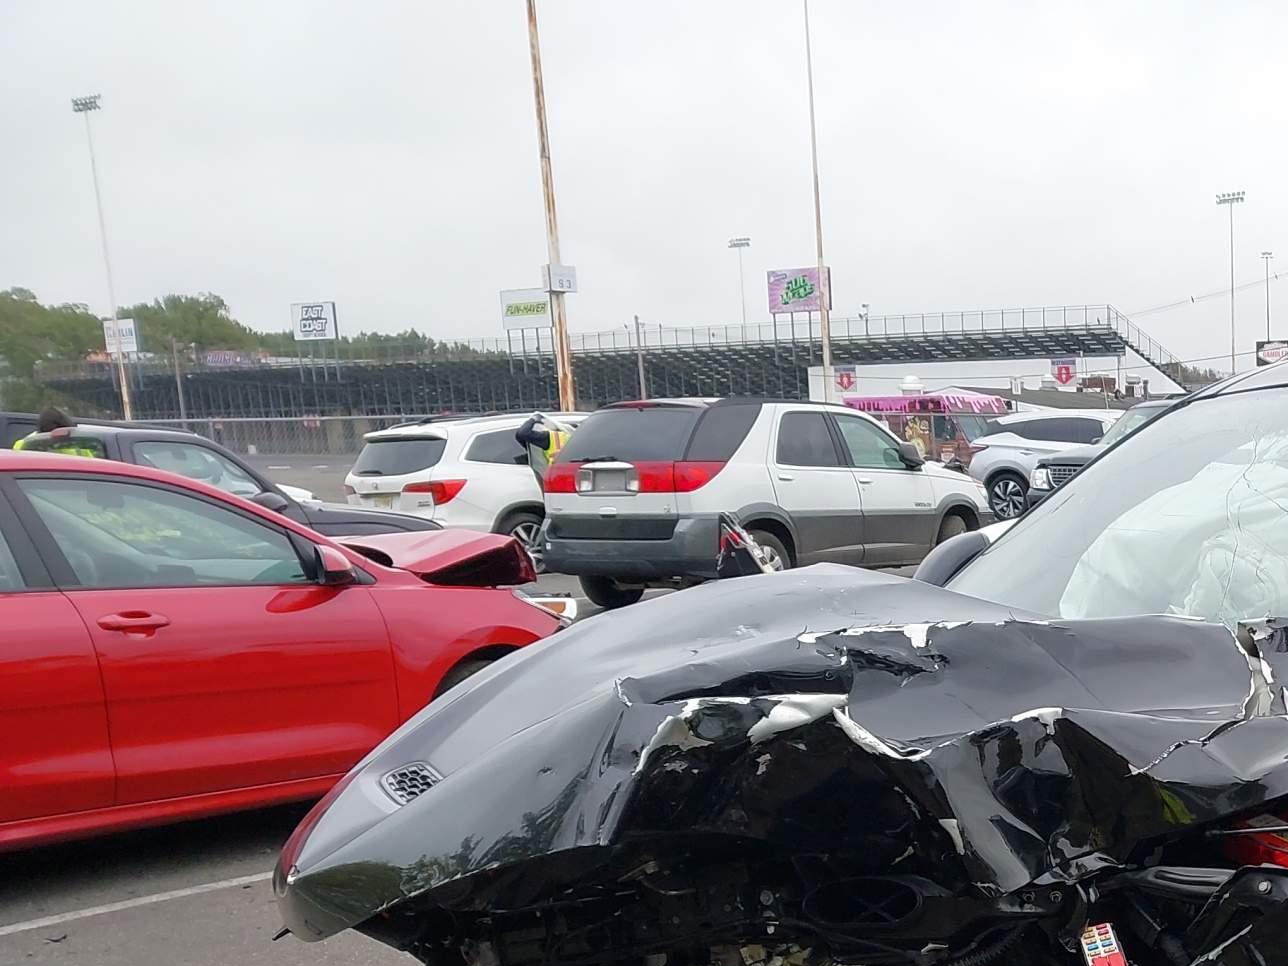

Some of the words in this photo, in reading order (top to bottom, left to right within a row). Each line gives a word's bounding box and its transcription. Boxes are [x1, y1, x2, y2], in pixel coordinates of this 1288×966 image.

[301, 305, 323, 319] EAST
[505, 303, 546, 315] FUN-HAVER
[300, 318, 327, 332] COAST
